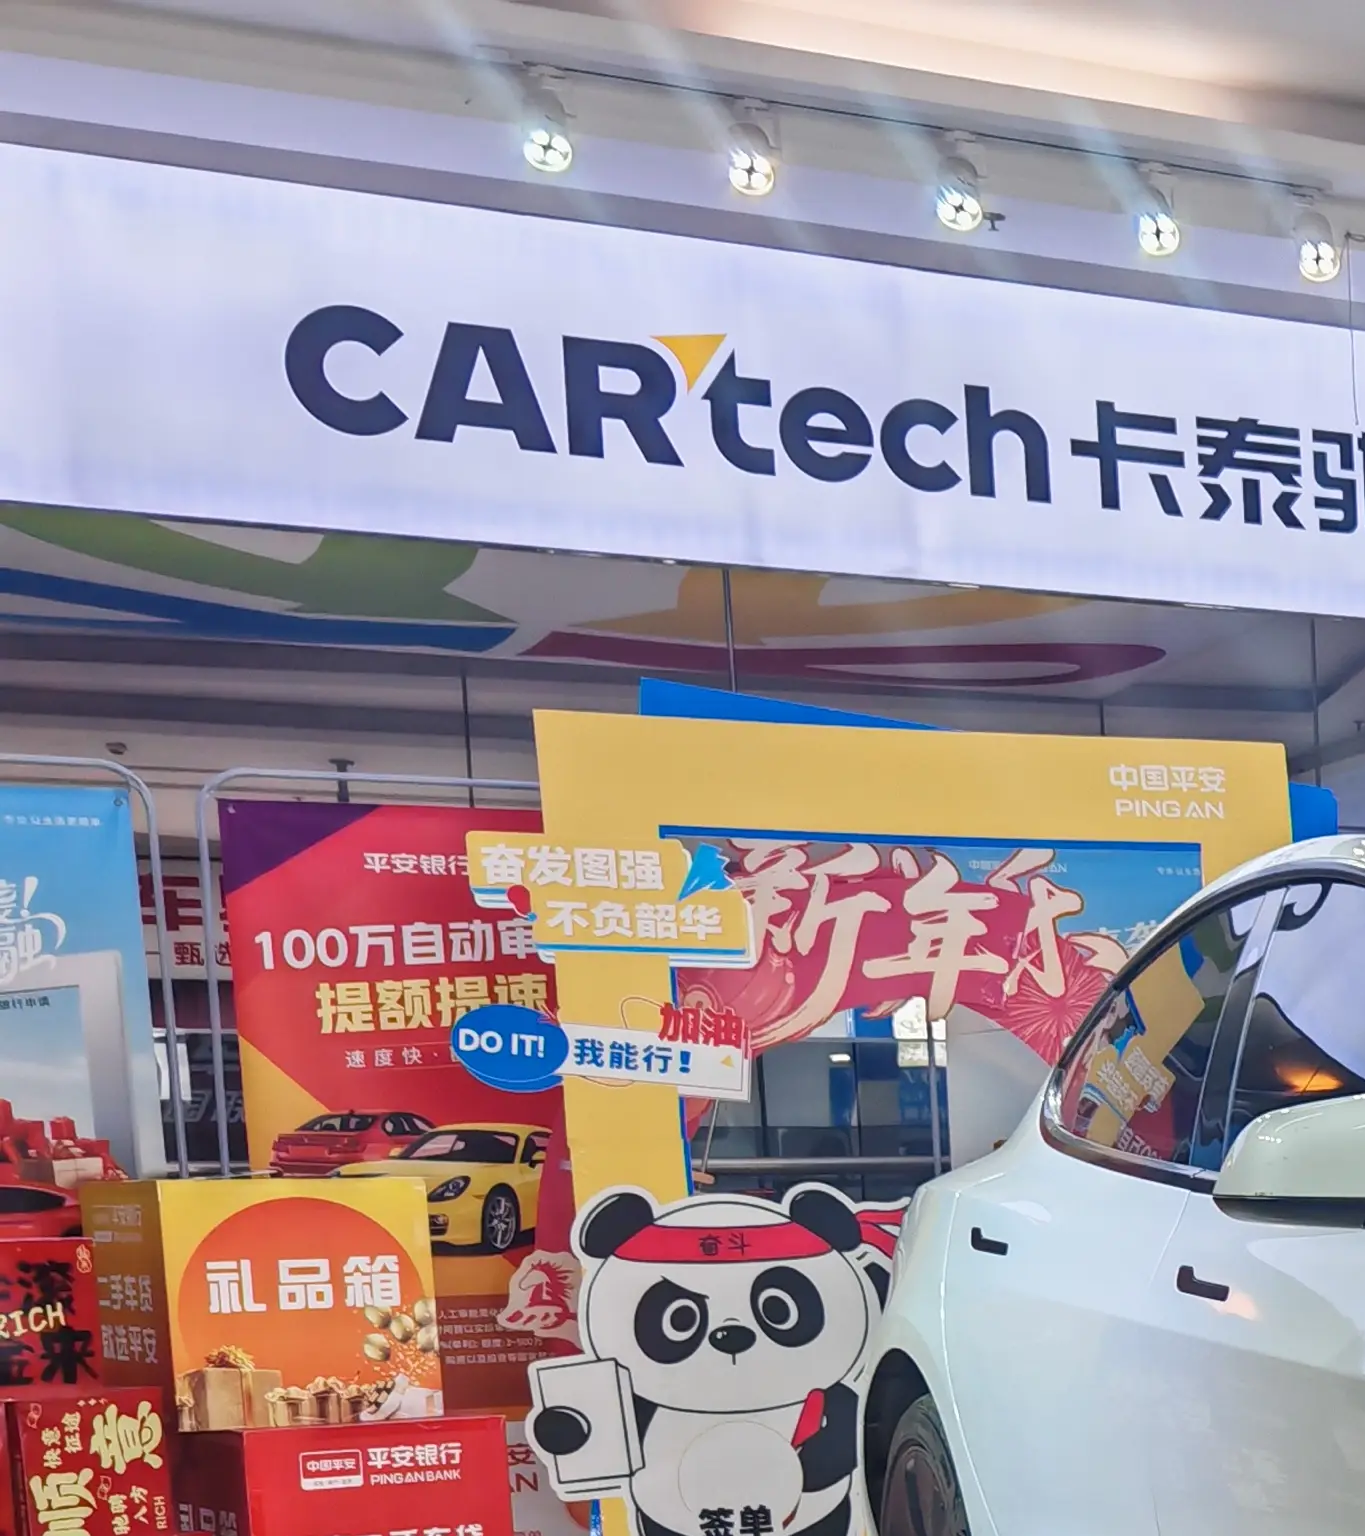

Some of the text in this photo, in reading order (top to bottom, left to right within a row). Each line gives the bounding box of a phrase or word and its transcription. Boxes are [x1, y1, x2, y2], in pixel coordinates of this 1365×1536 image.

[284, 304, 1051, 504] CARtech
[1109, 764, 1226, 792] 中国平安
[363, 851, 469, 877] 平安银行
[481, 843, 664, 890] 奋发图强
[546, 900, 723, 941] 不负韶华
[316, 972, 550, 1034] 提额提速
[658, 1002, 741, 1049] 加油
[459, 1029, 545, 1058] DO IT!
[699, 1231, 750, 1256] 奋斗
[206, 1255, 400, 1314] 礼品箱
[306, 1458, 356, 1472] 中国平安
[367, 1443, 462, 1469] 平安银行
[153, 1496, 168, 1530] RICH
